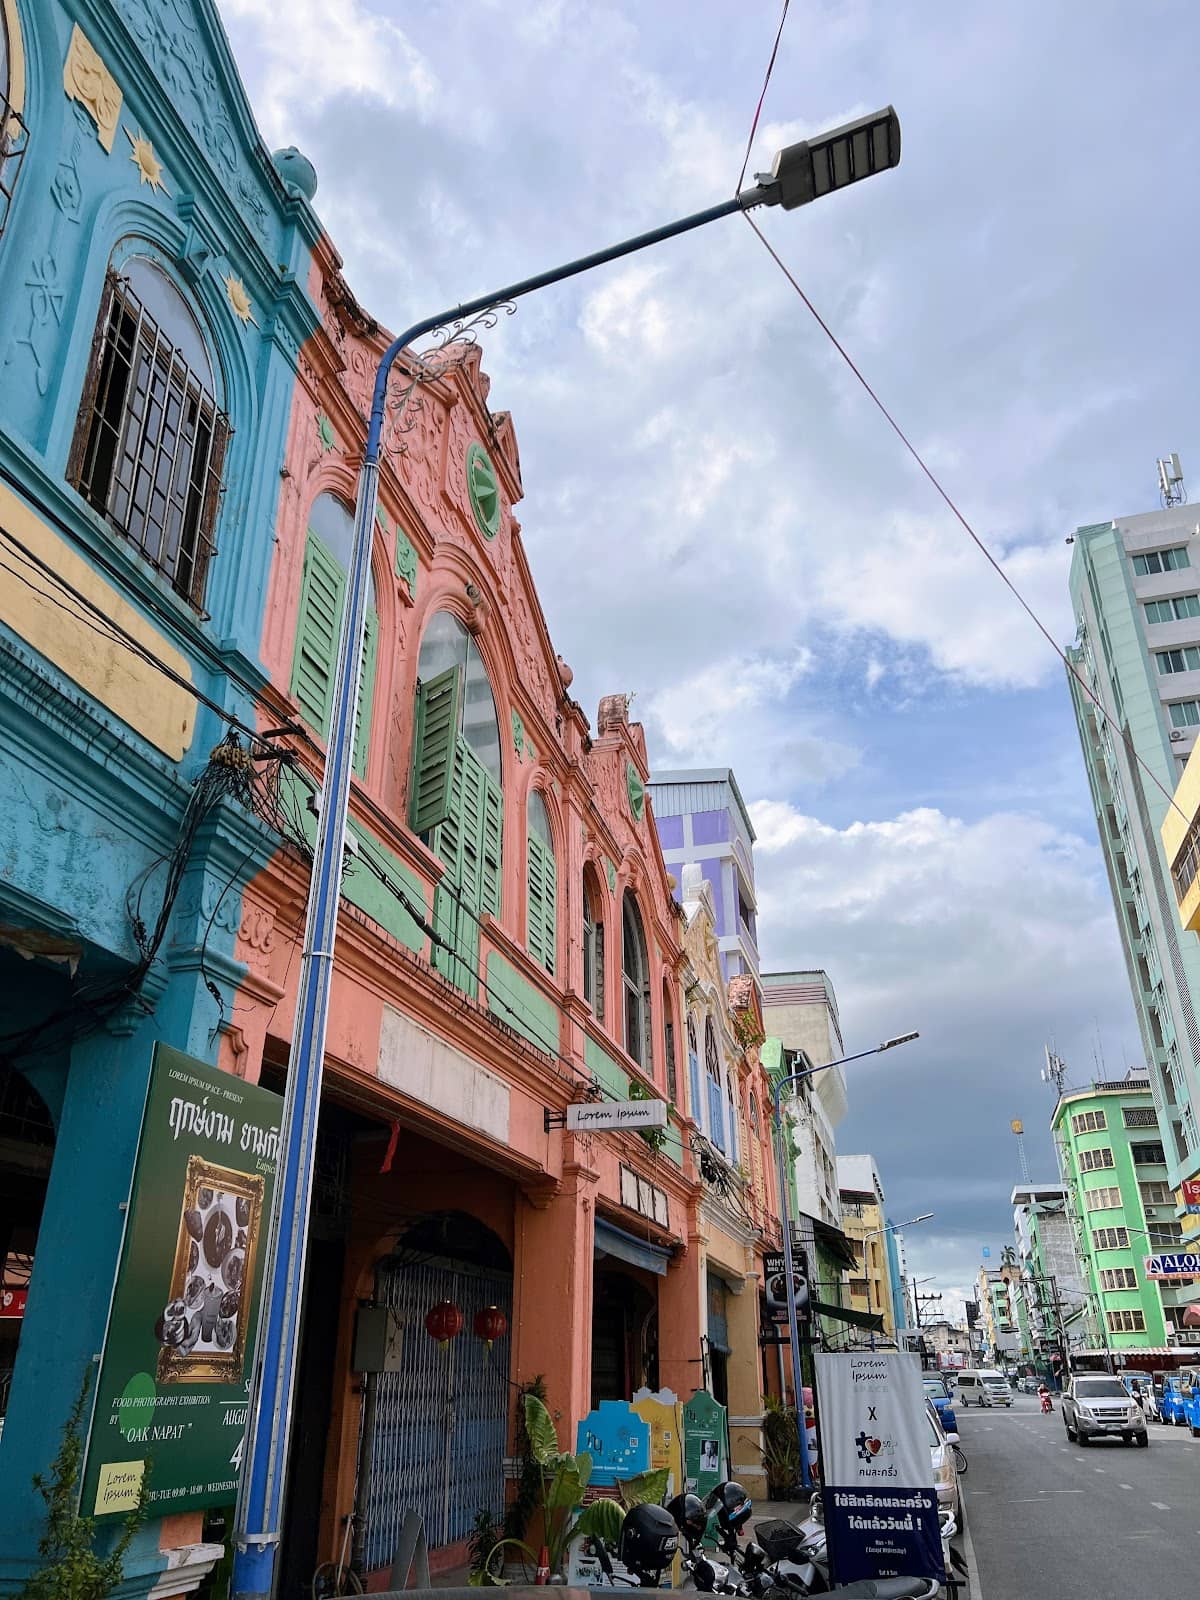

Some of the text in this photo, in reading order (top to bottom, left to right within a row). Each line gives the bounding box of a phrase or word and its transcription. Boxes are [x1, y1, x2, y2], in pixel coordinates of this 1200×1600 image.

[168, 1069, 189, 1084] LOREM
[205, 1083, 221, 1095] SPACE
[223, 1091, 243, 1104] PRESENT
[577, 1108, 650, 1121] Lorem Ipsum
[850, 1359, 887, 1368] Lorem
[852, 1370, 887, 1383] Ipsum
[111, 1395, 211, 1408] FOOD PHOTOGRAPHY EXHIBITION
[110, 1414, 120, 1425] BY
[107, 1471, 137, 1486] Lorem
[103, 1486, 135, 1505] Ipsum
